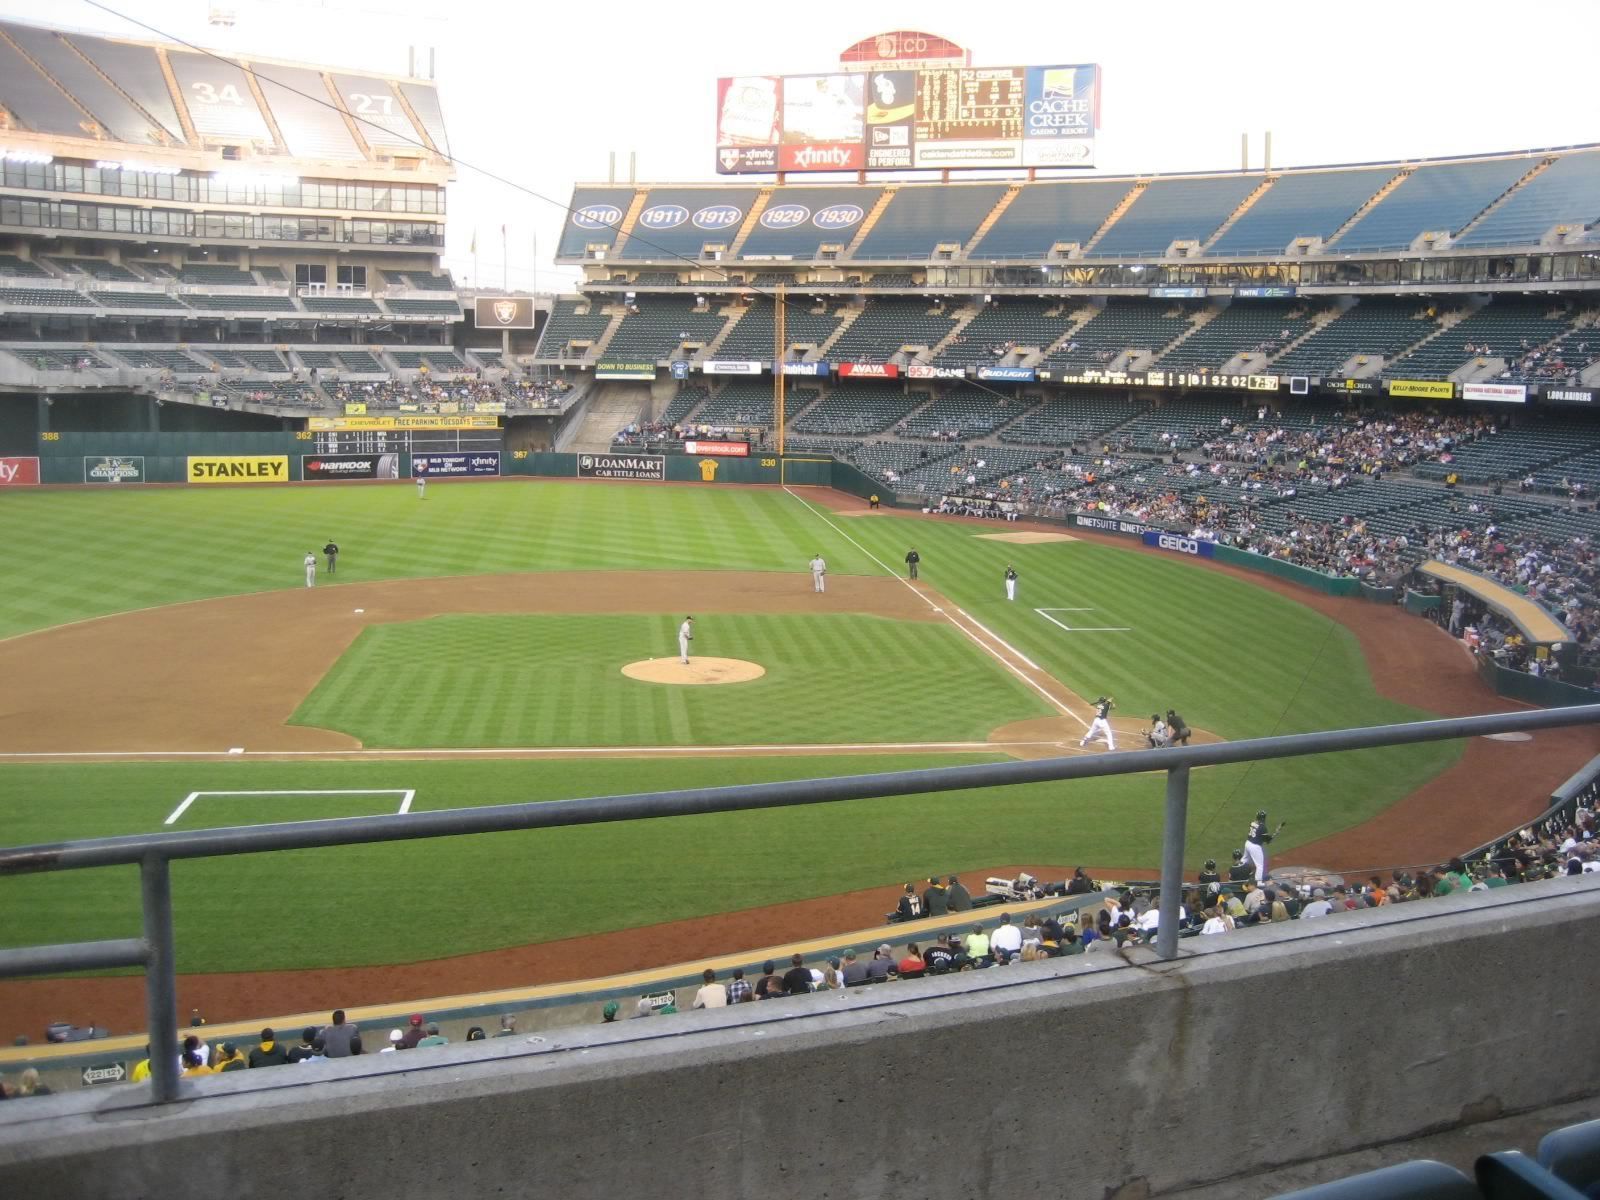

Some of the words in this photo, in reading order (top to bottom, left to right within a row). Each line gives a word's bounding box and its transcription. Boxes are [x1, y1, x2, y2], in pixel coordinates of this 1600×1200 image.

[192, 82, 244, 105] 34
[349, 94, 393, 114] 27
[1029, 99, 1089, 113] CACHE
[1029, 113, 1089, 127] CREEK
[746, 149, 775, 160] xfinity
[794, 146, 852, 168] xfinity
[869, 148, 911, 157] ENGINEERED
[920, 149, 1015, 160] oaklandathletics.com
[868, 158, 876, 166] TO
[579, 210, 618, 223] 1910
[646, 210, 683, 223] 1911
[698, 210, 737, 223] 1913
[766, 210, 804, 223] 1929
[819, 210, 858, 223] 1930
[624, 363, 654, 371] BUSINESS
[851, 364, 886, 374] AVAYA
[909, 366, 932, 377] 95.7
[936, 367, 966, 378] GAME
[983, 369, 1003, 377] BUD
[1004, 370, 1032, 378] LIGHT
[1254, 377, 1276, 388] 7:57
[1392, 385, 1429, 393] KELLY-MOORE
[1430, 386, 1450, 394] PAINTS
[393, 418, 410, 426] FREE
[411, 418, 439, 426] PARKING
[440, 418, 471, 426] TUESDAYS
[296, 431, 312, 440] 362
[513, 451, 528, 459] 367
[696, 444, 747, 455] overstock.com
[471, 457, 498, 466] xfinity
[594, 457, 663, 470] LOANMART
[761, 458, 776, 467] 330
[90, 469, 139, 477] CHAMPIONS
[193, 462, 283, 477] STANLEY
[596, 469, 613, 477] CAR
[635, 471, 661, 479] LOANS
[1083, 518, 1118, 531] NETSUITE
[1158, 534, 1198, 554] GEICO
[911, 902, 921, 915] 14
[660, 995, 673, 1004] 120
[86, 1070, 102, 1079] 122
[106, 1068, 121, 1077] 121
